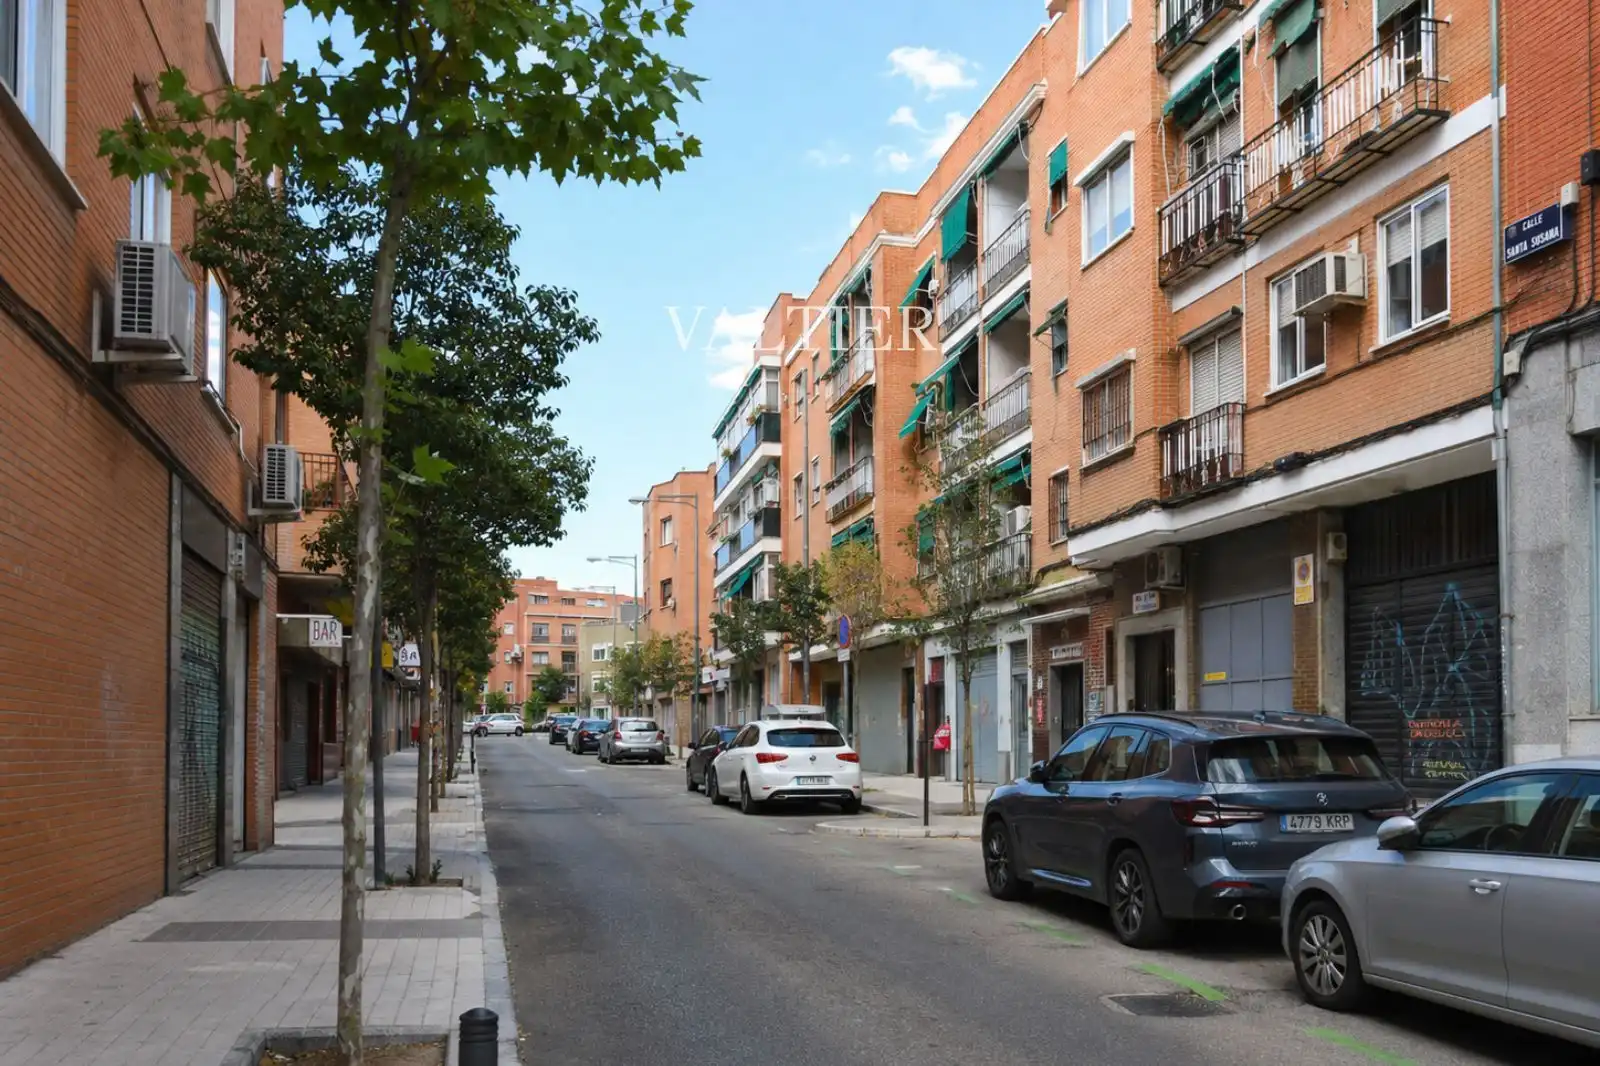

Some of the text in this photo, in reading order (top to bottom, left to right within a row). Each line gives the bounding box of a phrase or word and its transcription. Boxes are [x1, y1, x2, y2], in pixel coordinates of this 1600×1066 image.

[1522, 214, 1543, 230] CALLE
[1506, 226, 1559, 259] SANTA SUSANA
[313, 620, 337, 640] BAR
[1290, 815, 1350, 829] 4779 KRP
